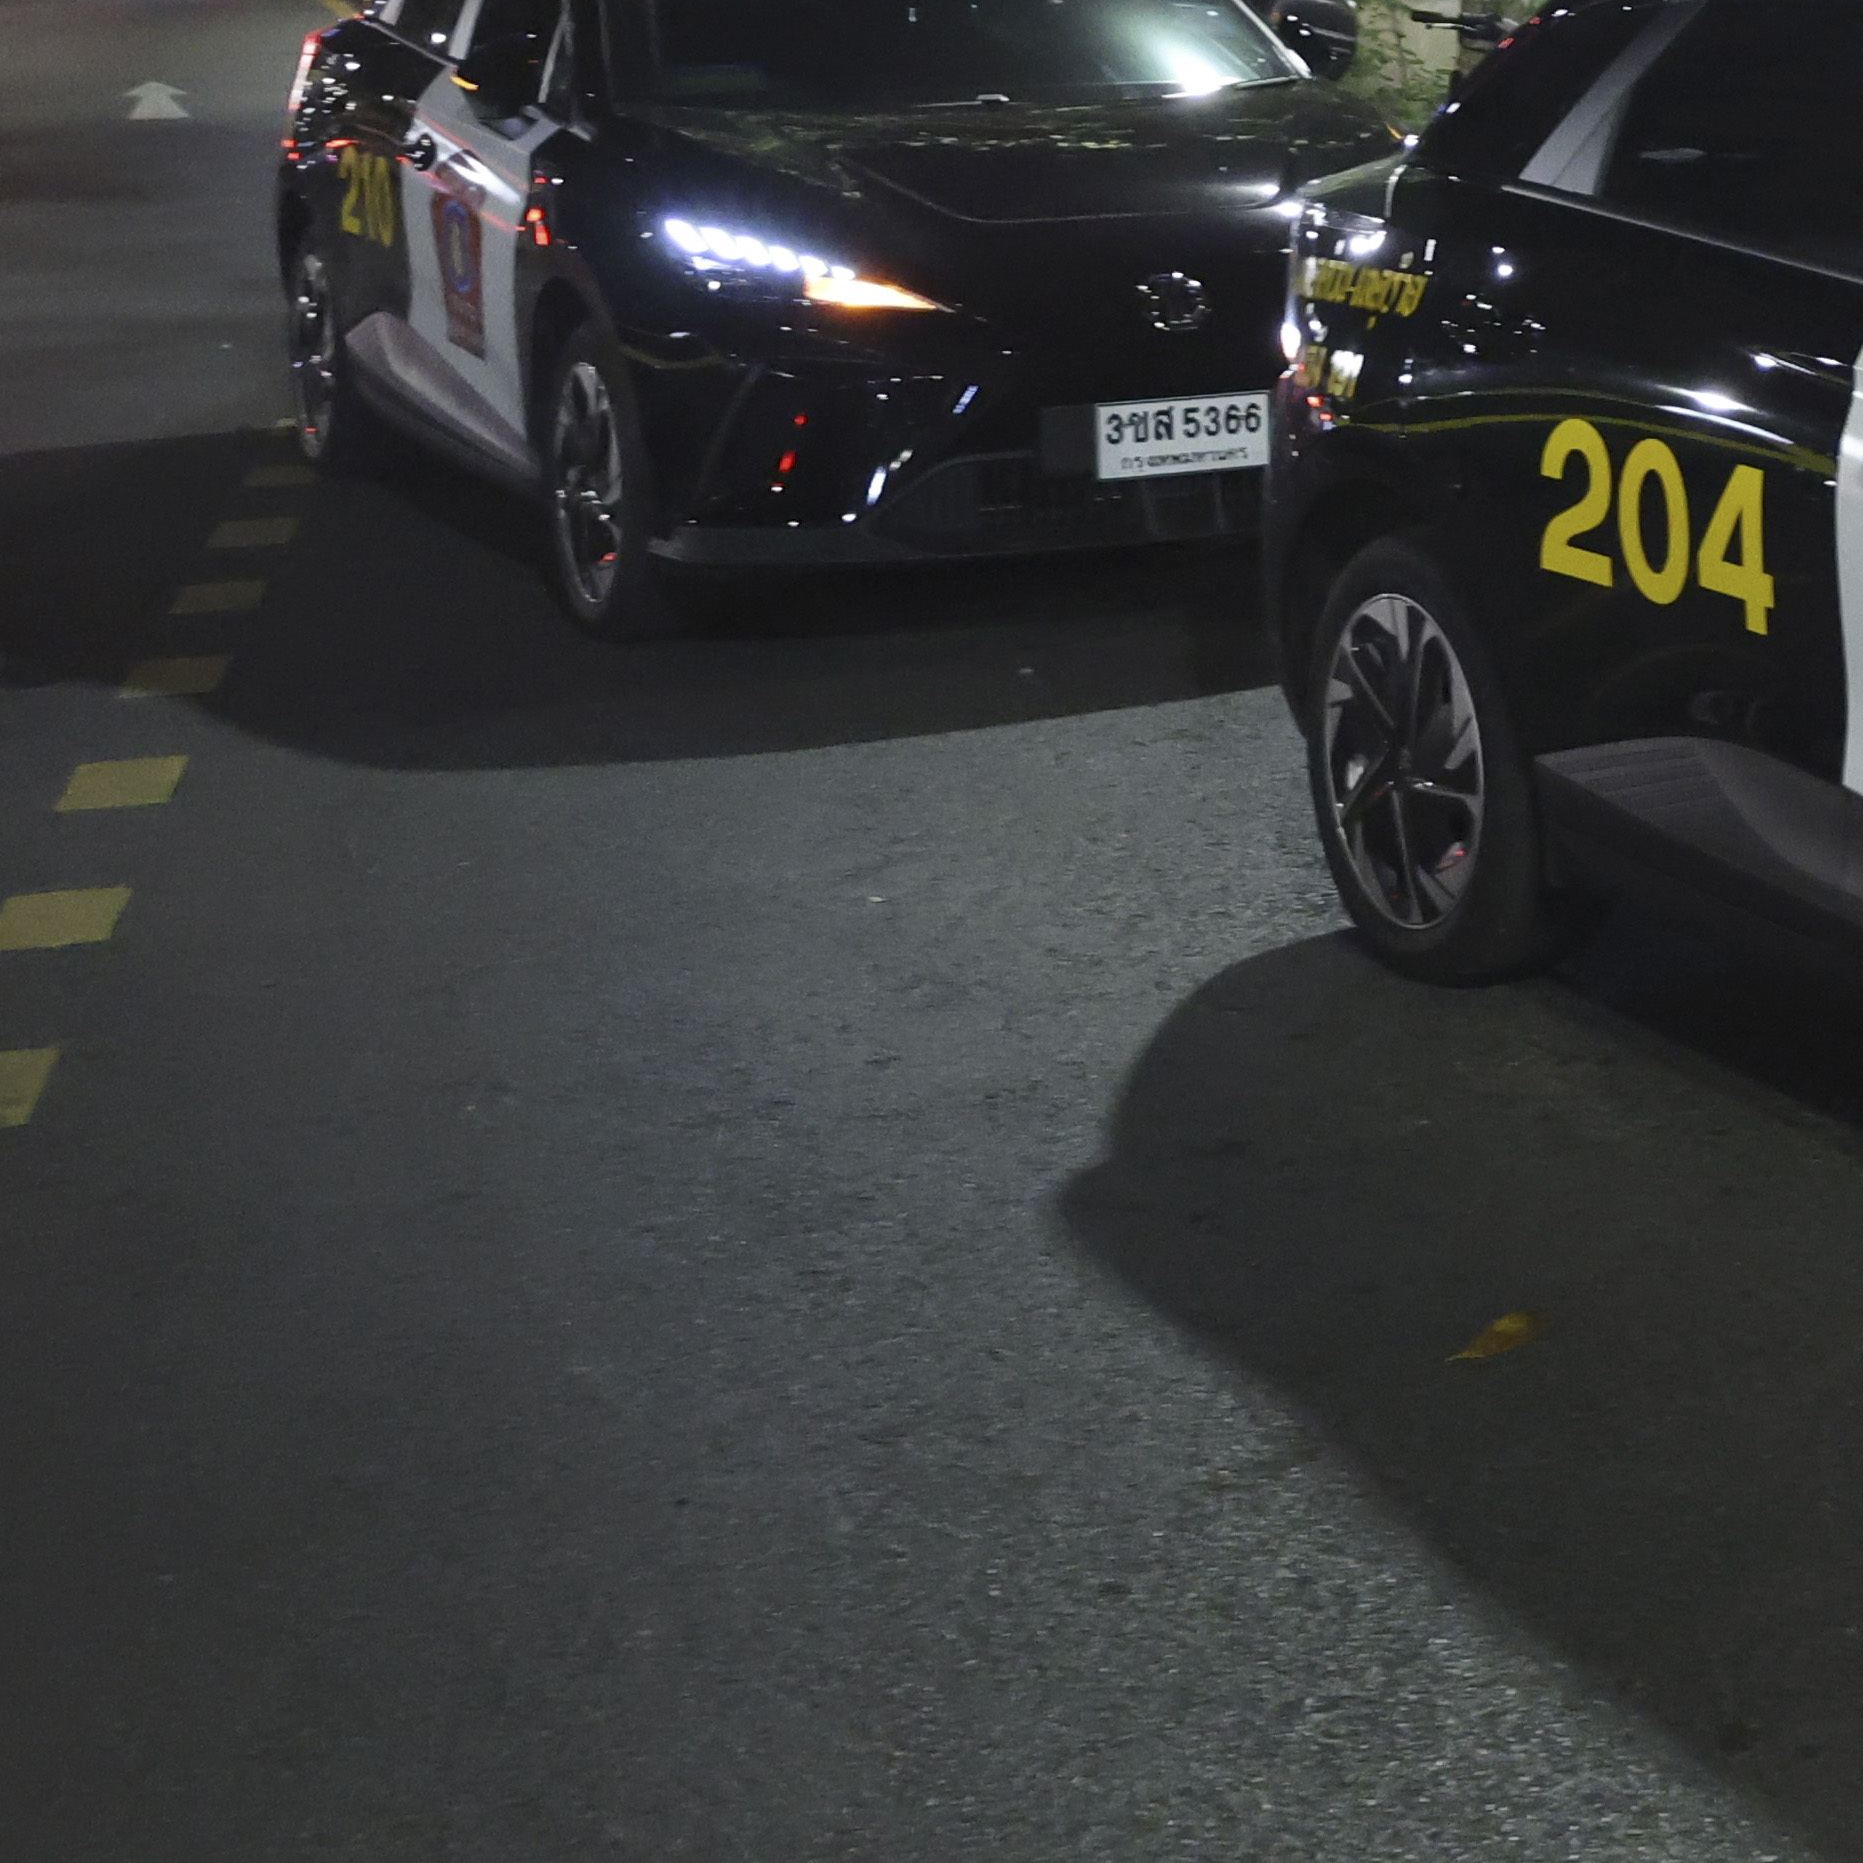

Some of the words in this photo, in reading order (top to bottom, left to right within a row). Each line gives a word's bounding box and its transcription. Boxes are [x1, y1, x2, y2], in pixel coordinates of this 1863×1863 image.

[1106, 405, 1175, 445] 3ขส
[1182, 402, 1262, 438] 5366
[1540, 419, 1774, 635] 204
